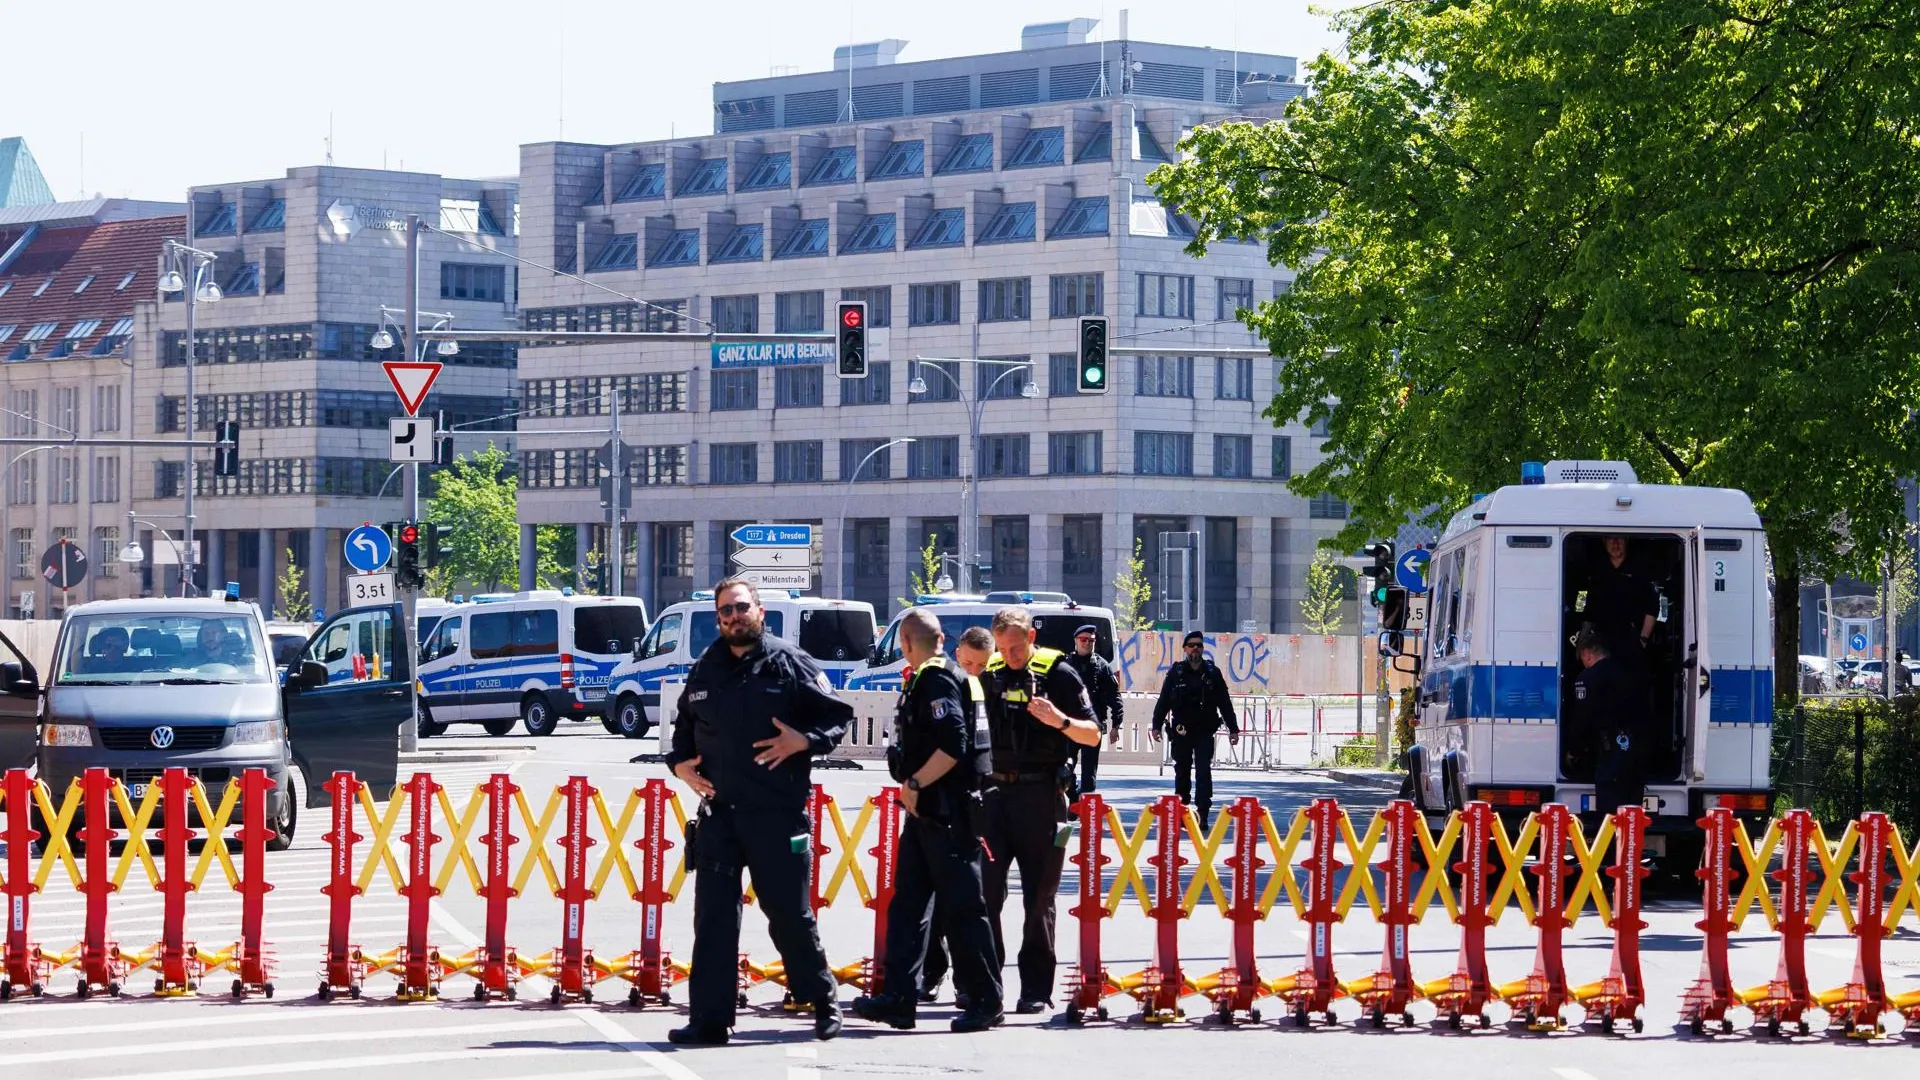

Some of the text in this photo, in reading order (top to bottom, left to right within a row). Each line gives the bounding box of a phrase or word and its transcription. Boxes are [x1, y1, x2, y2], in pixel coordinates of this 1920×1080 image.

[360, 205, 396, 218] Berliner
[719, 345, 745, 362] GANZ
[747, 344, 772, 360] KLAR
[762, 575, 805, 584] Mühlenstraße
[780, 531, 806, 540] Dresden
[1715, 561, 1724, 576] 3
[476, 679, 501, 688] POLIZEI
[339, 777, 347, 875] www.zufahrtssperre.de
[417, 777, 427, 875] www.zufahrtssperre.de
[495, 778, 504, 876] www.zufahrtssperre.de
[572, 780, 582, 879] www.zufahrtssperre.de
[651, 783, 661, 881] www.zufahrtssperre.de
[884, 791, 895, 889] www.zufahrtssperre.de
[1088, 798, 1096, 896] www.zufahrtssperre.de
[1166, 801, 1174, 898] www.zufahrtssperre.de
[1242, 802, 1251, 899] www.zufahrtssperre.de
[1320, 802, 1329, 900] www.zufahrtssperre.de
[1396, 805, 1404, 903] www.zufahrtssperre.de
[1473, 808, 1481, 906] www.zufahrtssperre.de
[1550, 810, 1559, 908] www.zufahrtssperre.de
[1626, 810, 1635, 909] www.zufahrtssperre.de
[1715, 813, 1723, 911] www.zufahrtssperre.de
[1794, 815, 1803, 912] www.zufahrtssperre.de
[1869, 818, 1878, 915] www.zufahrtssperre.de
